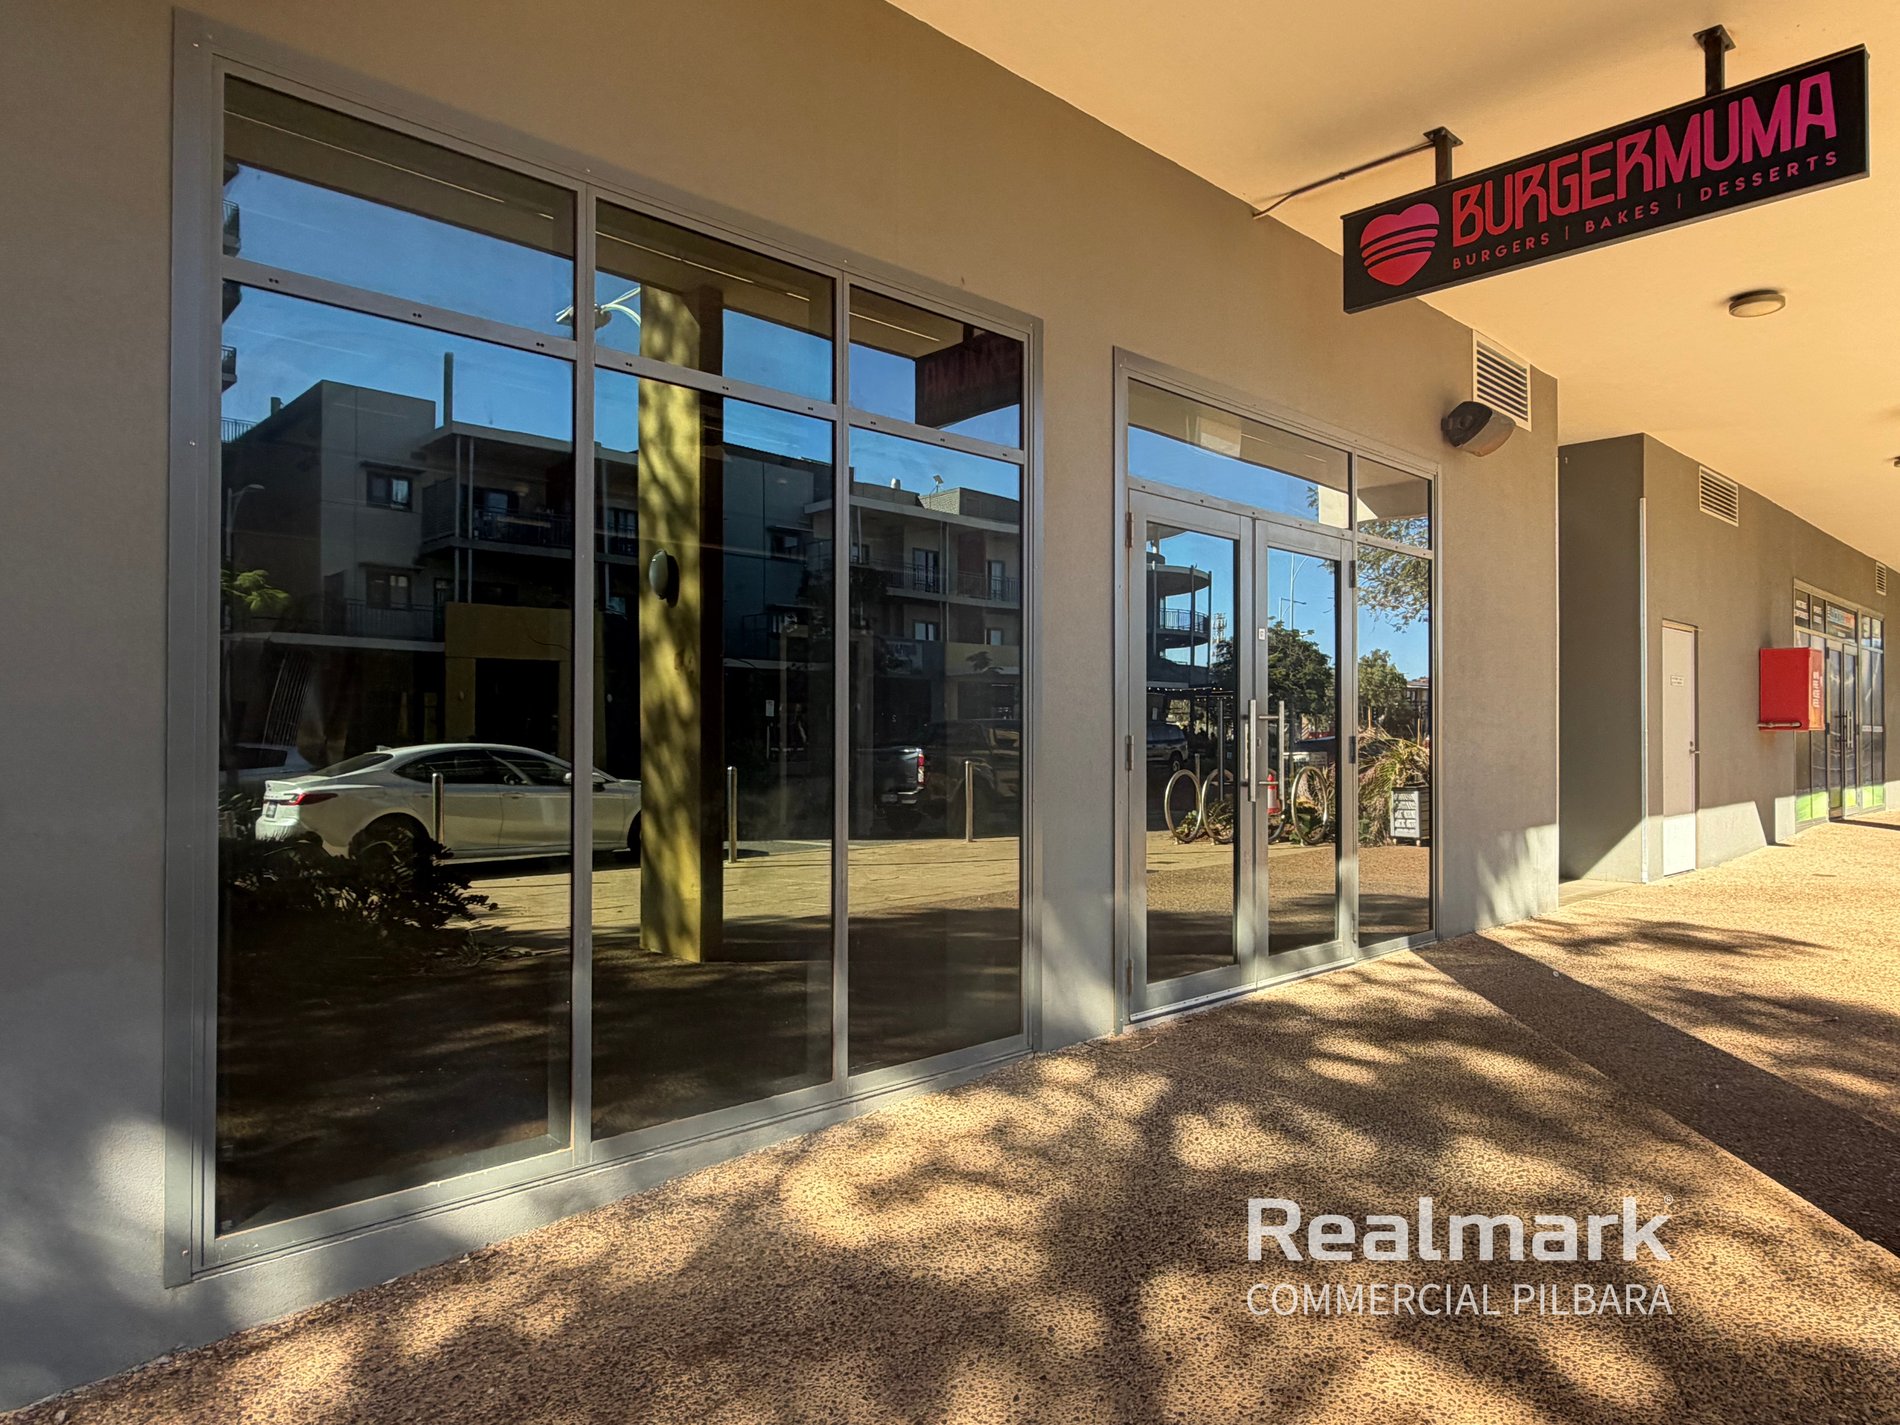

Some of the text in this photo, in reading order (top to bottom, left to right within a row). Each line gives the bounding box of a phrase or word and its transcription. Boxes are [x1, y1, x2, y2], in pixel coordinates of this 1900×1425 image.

[1452, 71, 1837, 248] BURGERMUMA
[1452, 151, 1837, 270] BURGERS BAKES DESSERTS
